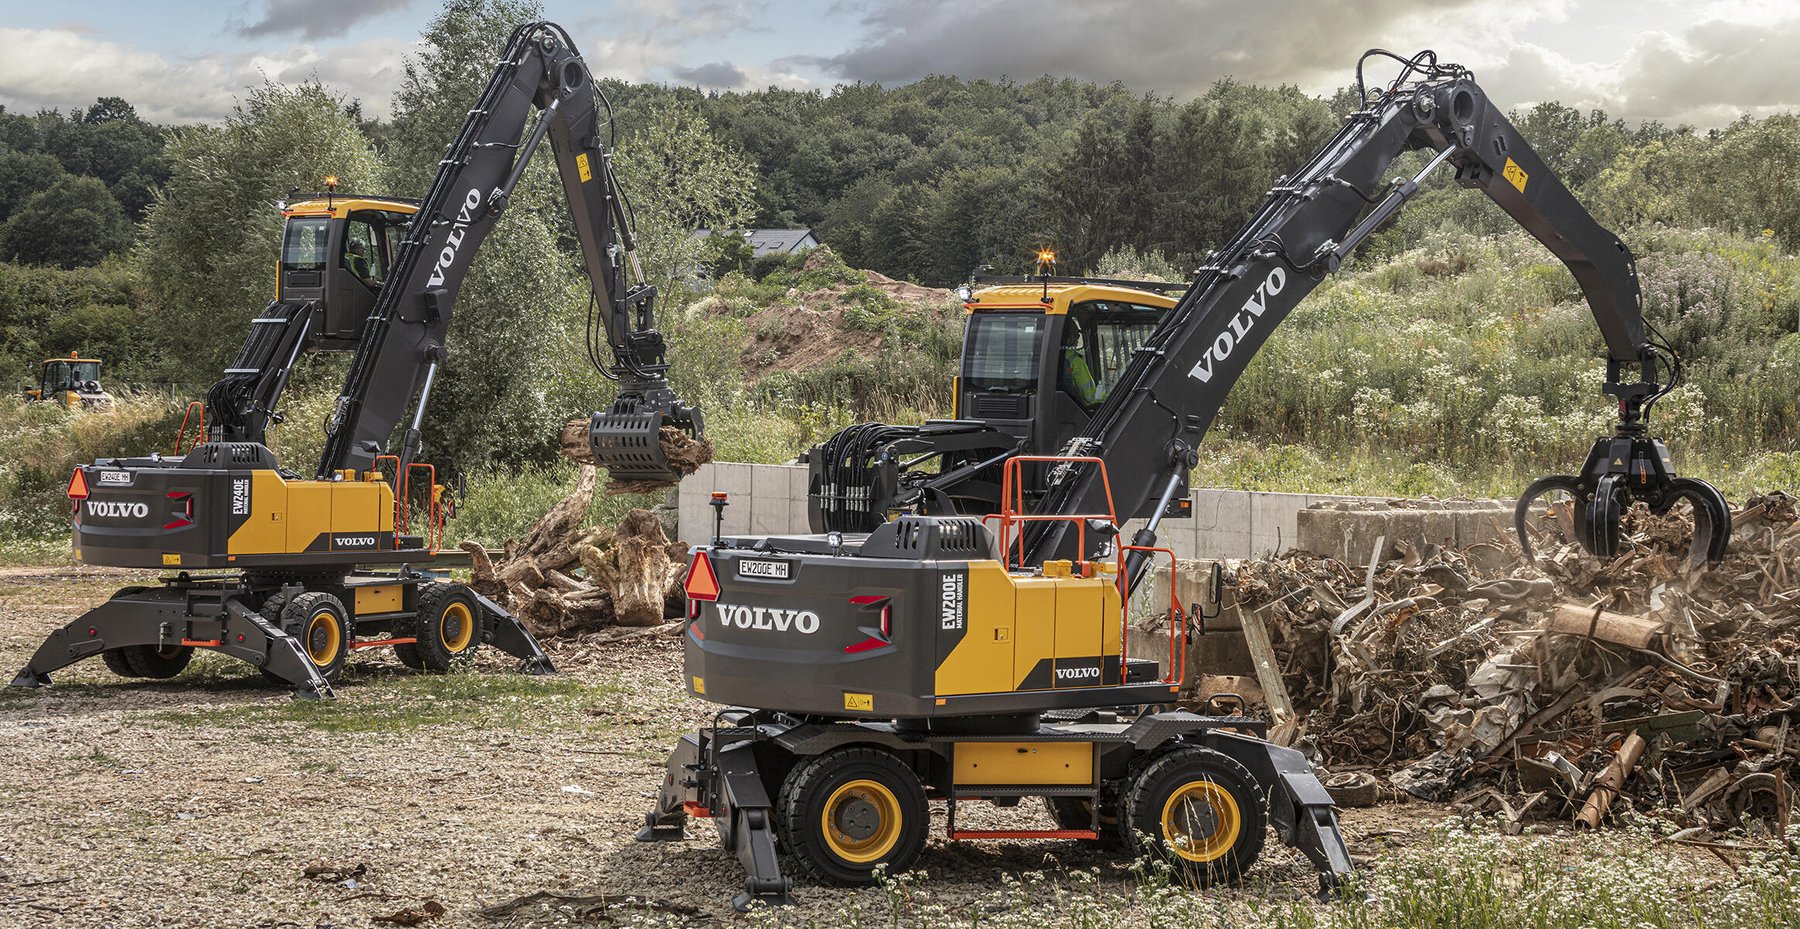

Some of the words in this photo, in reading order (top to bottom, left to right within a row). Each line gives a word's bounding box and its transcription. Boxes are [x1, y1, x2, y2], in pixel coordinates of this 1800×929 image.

[426, 188, 481, 288] VOLVO
[1187, 266, 1286, 383] VOLVO
[87, 501, 149, 518] VOLVO
[233, 479, 244, 514] EW240E
[335, 537, 375, 546] VOLVO
[741, 562, 772, 575] EW200E
[775, 565, 787, 576] MH
[942, 574, 956, 629] EW200E
[716, 604, 820, 634] VOLVO
[1056, 667, 1100, 679] VOLVO
